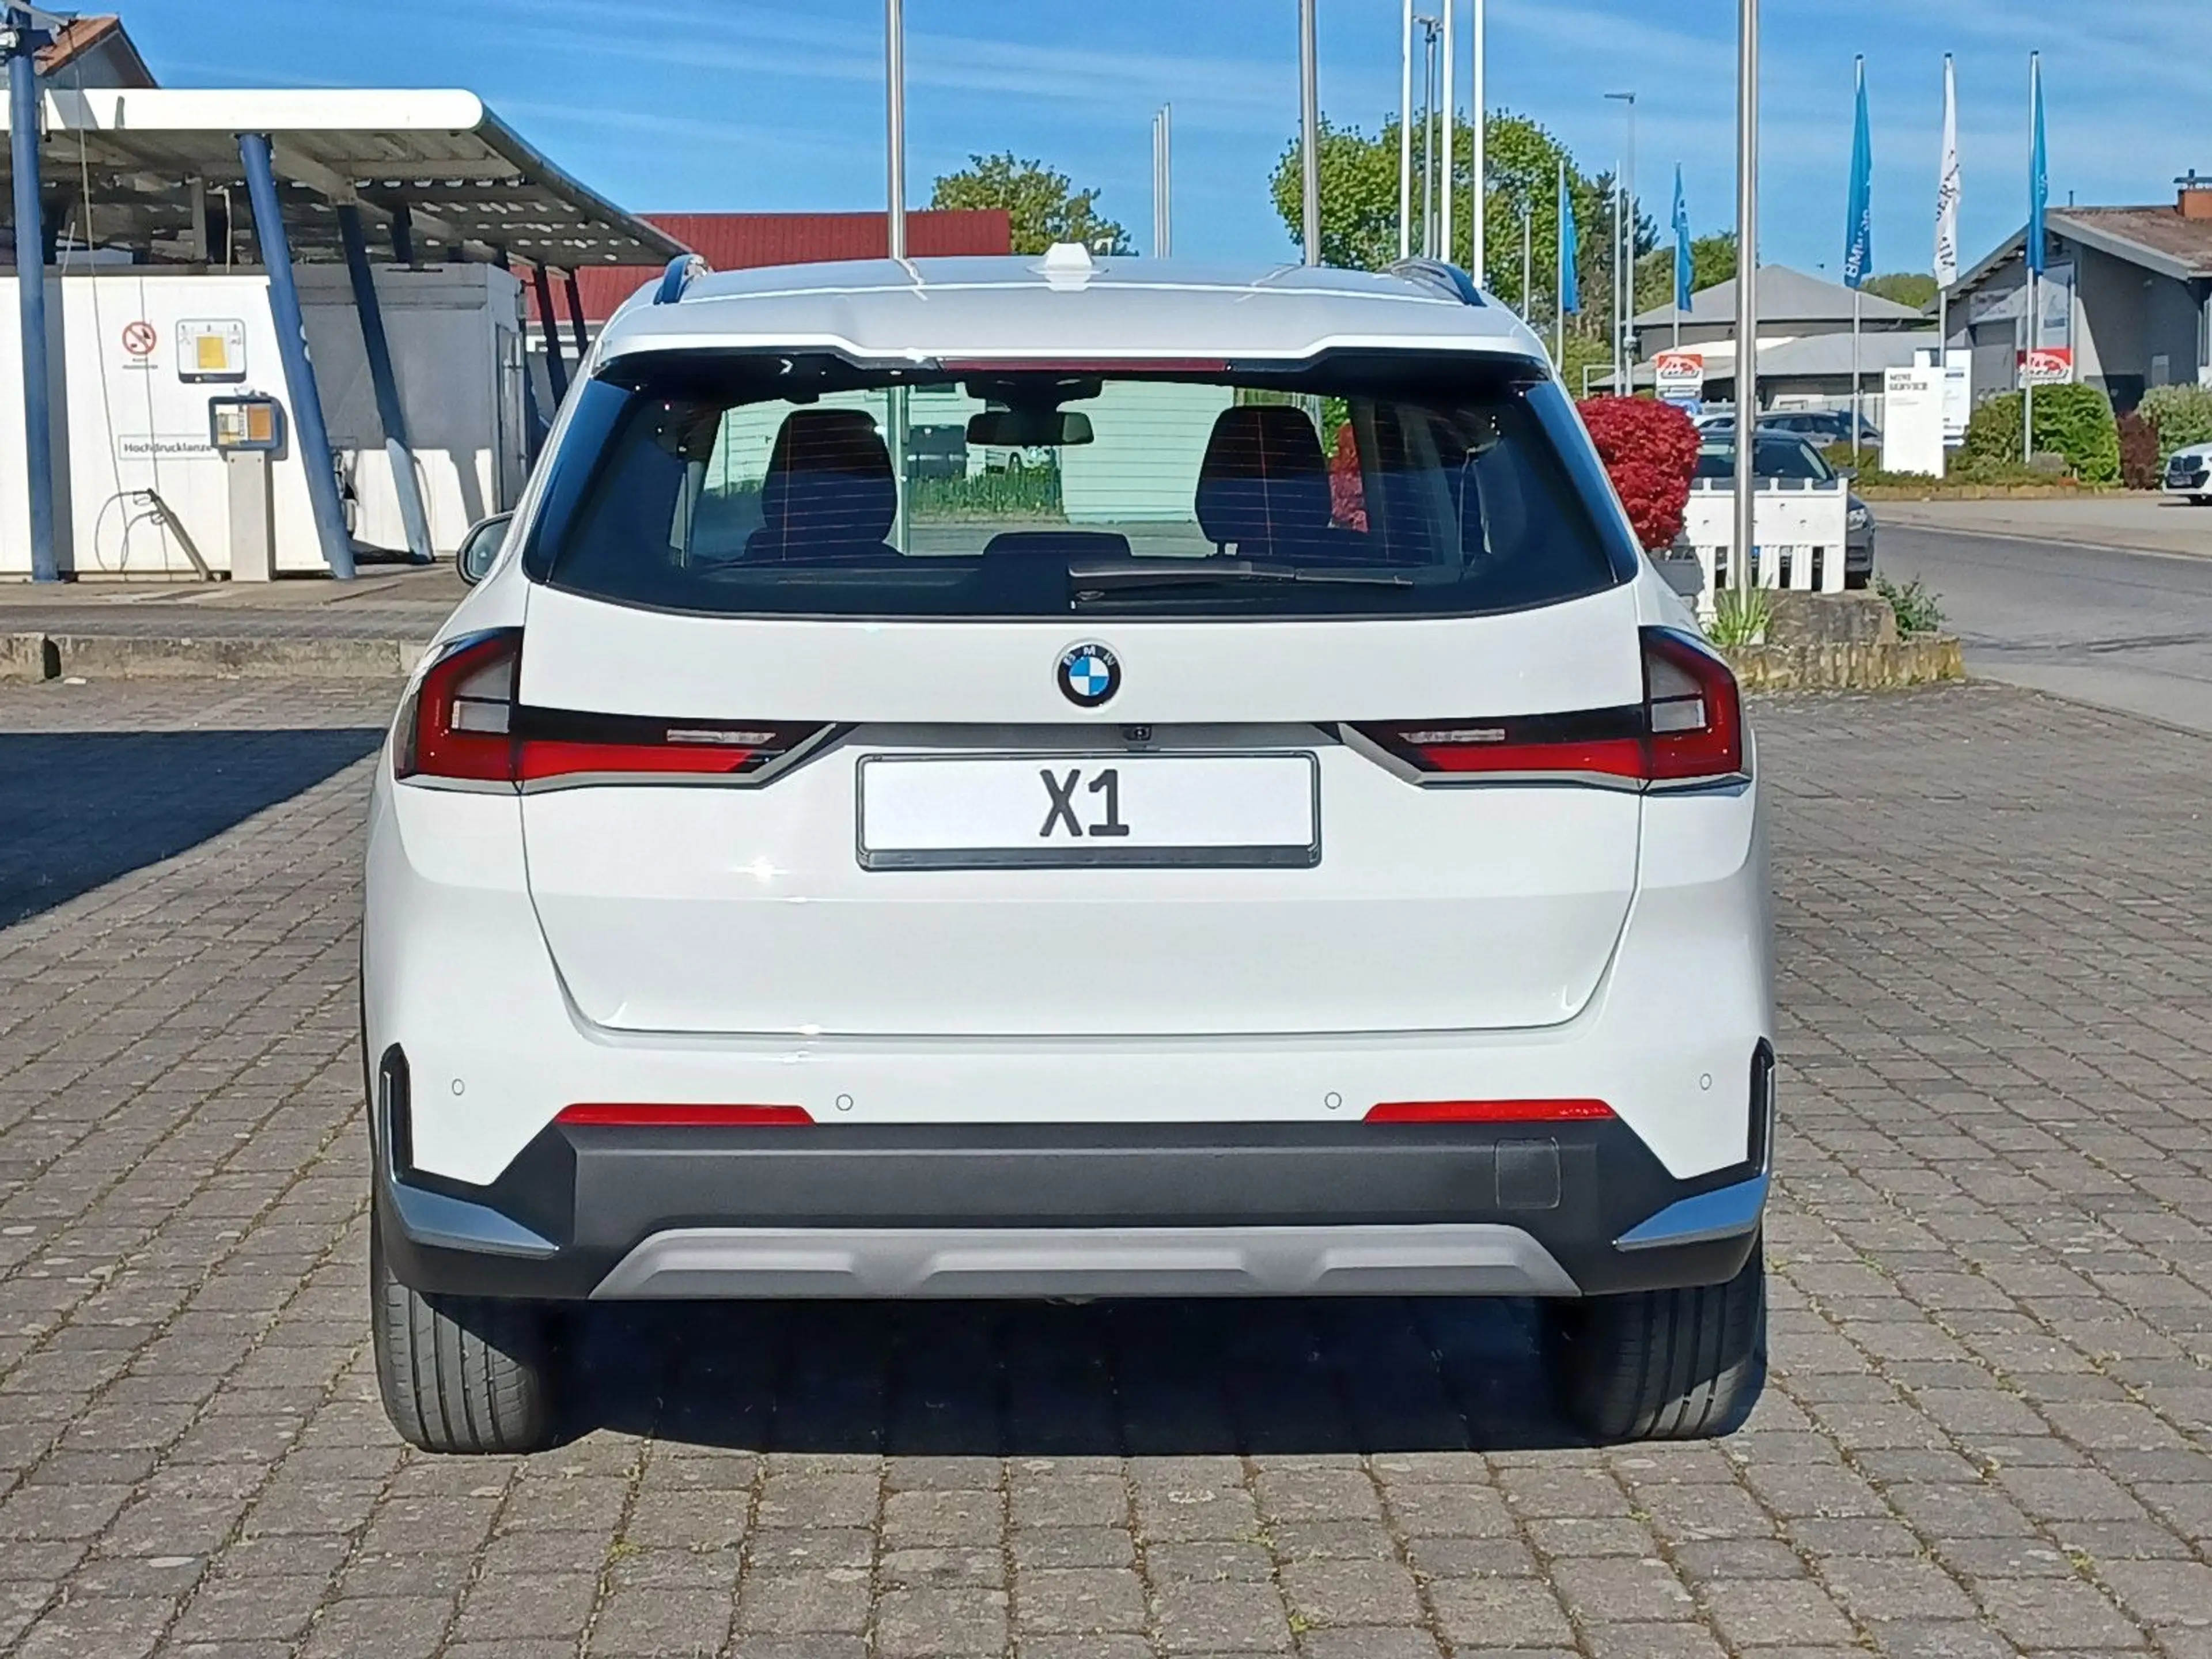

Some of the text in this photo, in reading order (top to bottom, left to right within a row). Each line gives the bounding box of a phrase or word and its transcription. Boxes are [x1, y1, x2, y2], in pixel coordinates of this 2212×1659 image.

[1889, 382, 1928, 391] SERVICE
[1063, 645, 1117, 666] BMW
[1039, 768, 1130, 837] X1
